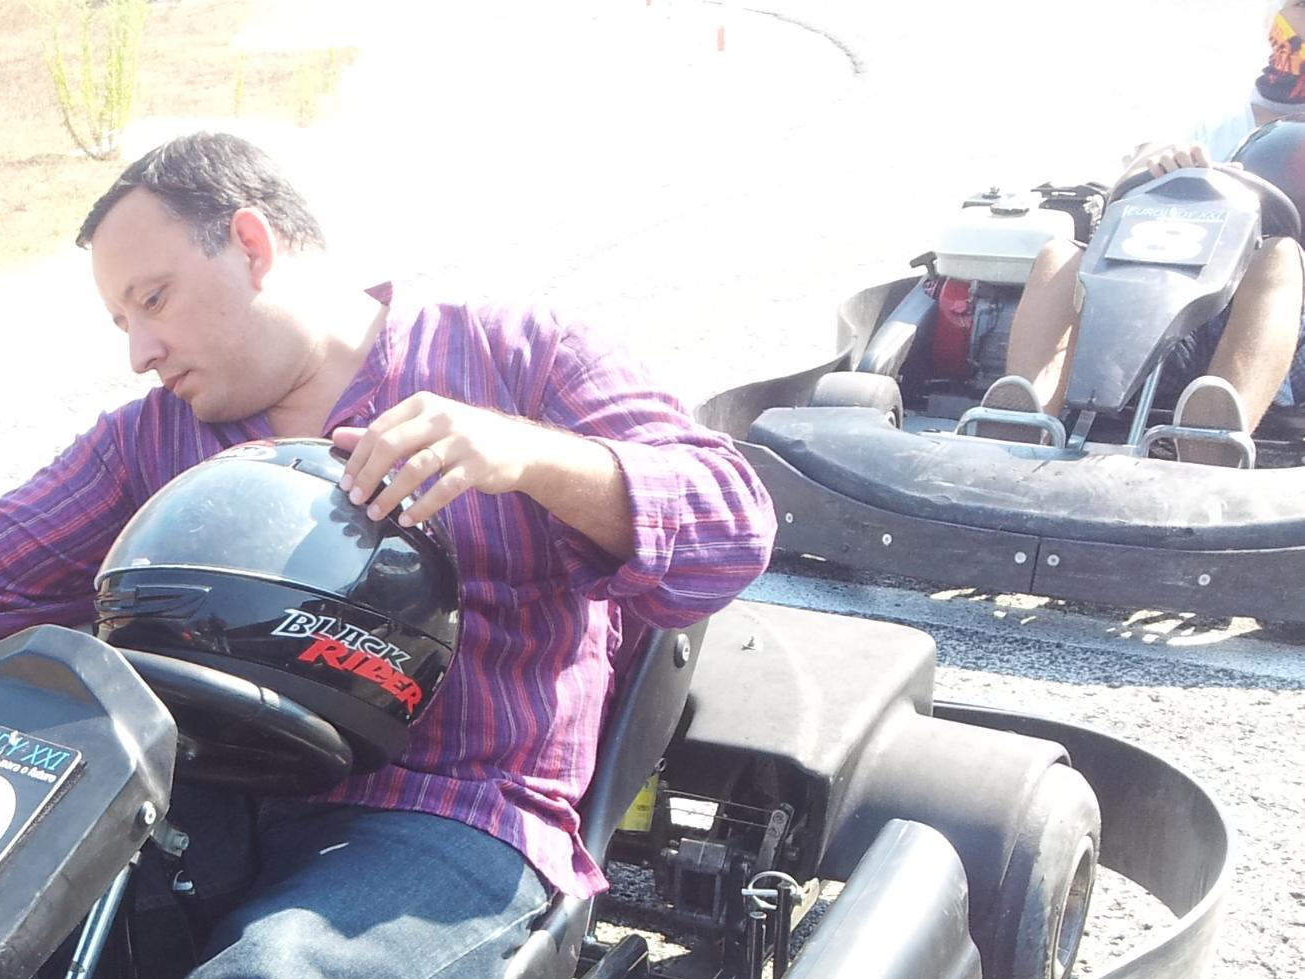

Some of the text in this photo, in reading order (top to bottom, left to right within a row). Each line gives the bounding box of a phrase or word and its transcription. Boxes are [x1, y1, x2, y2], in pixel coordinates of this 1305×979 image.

[1122, 221, 1207, 260] 8
[271, 608, 412, 674] BLACK
[298, 632, 423, 715] RIDER
[20, 744, 71, 771] XXI
